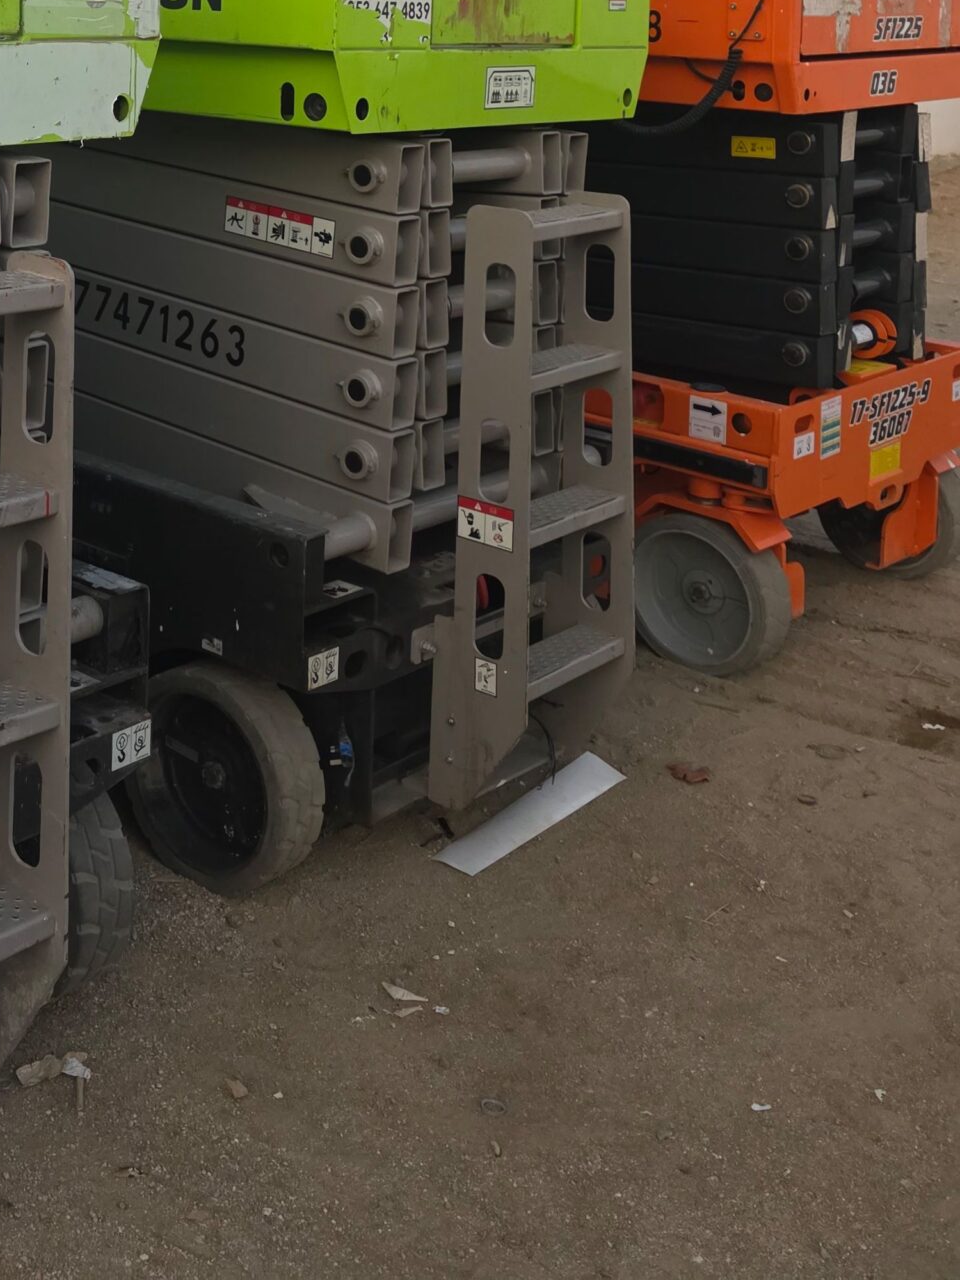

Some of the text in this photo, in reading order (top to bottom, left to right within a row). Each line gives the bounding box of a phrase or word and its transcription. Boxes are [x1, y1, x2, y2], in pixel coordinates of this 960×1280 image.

[401, 2, 430, 19] 4839
[873, 16, 923, 40] SF1225
[870, 71, 897, 95] 036
[850, 379, 931, 425] 17-SF1225-9
